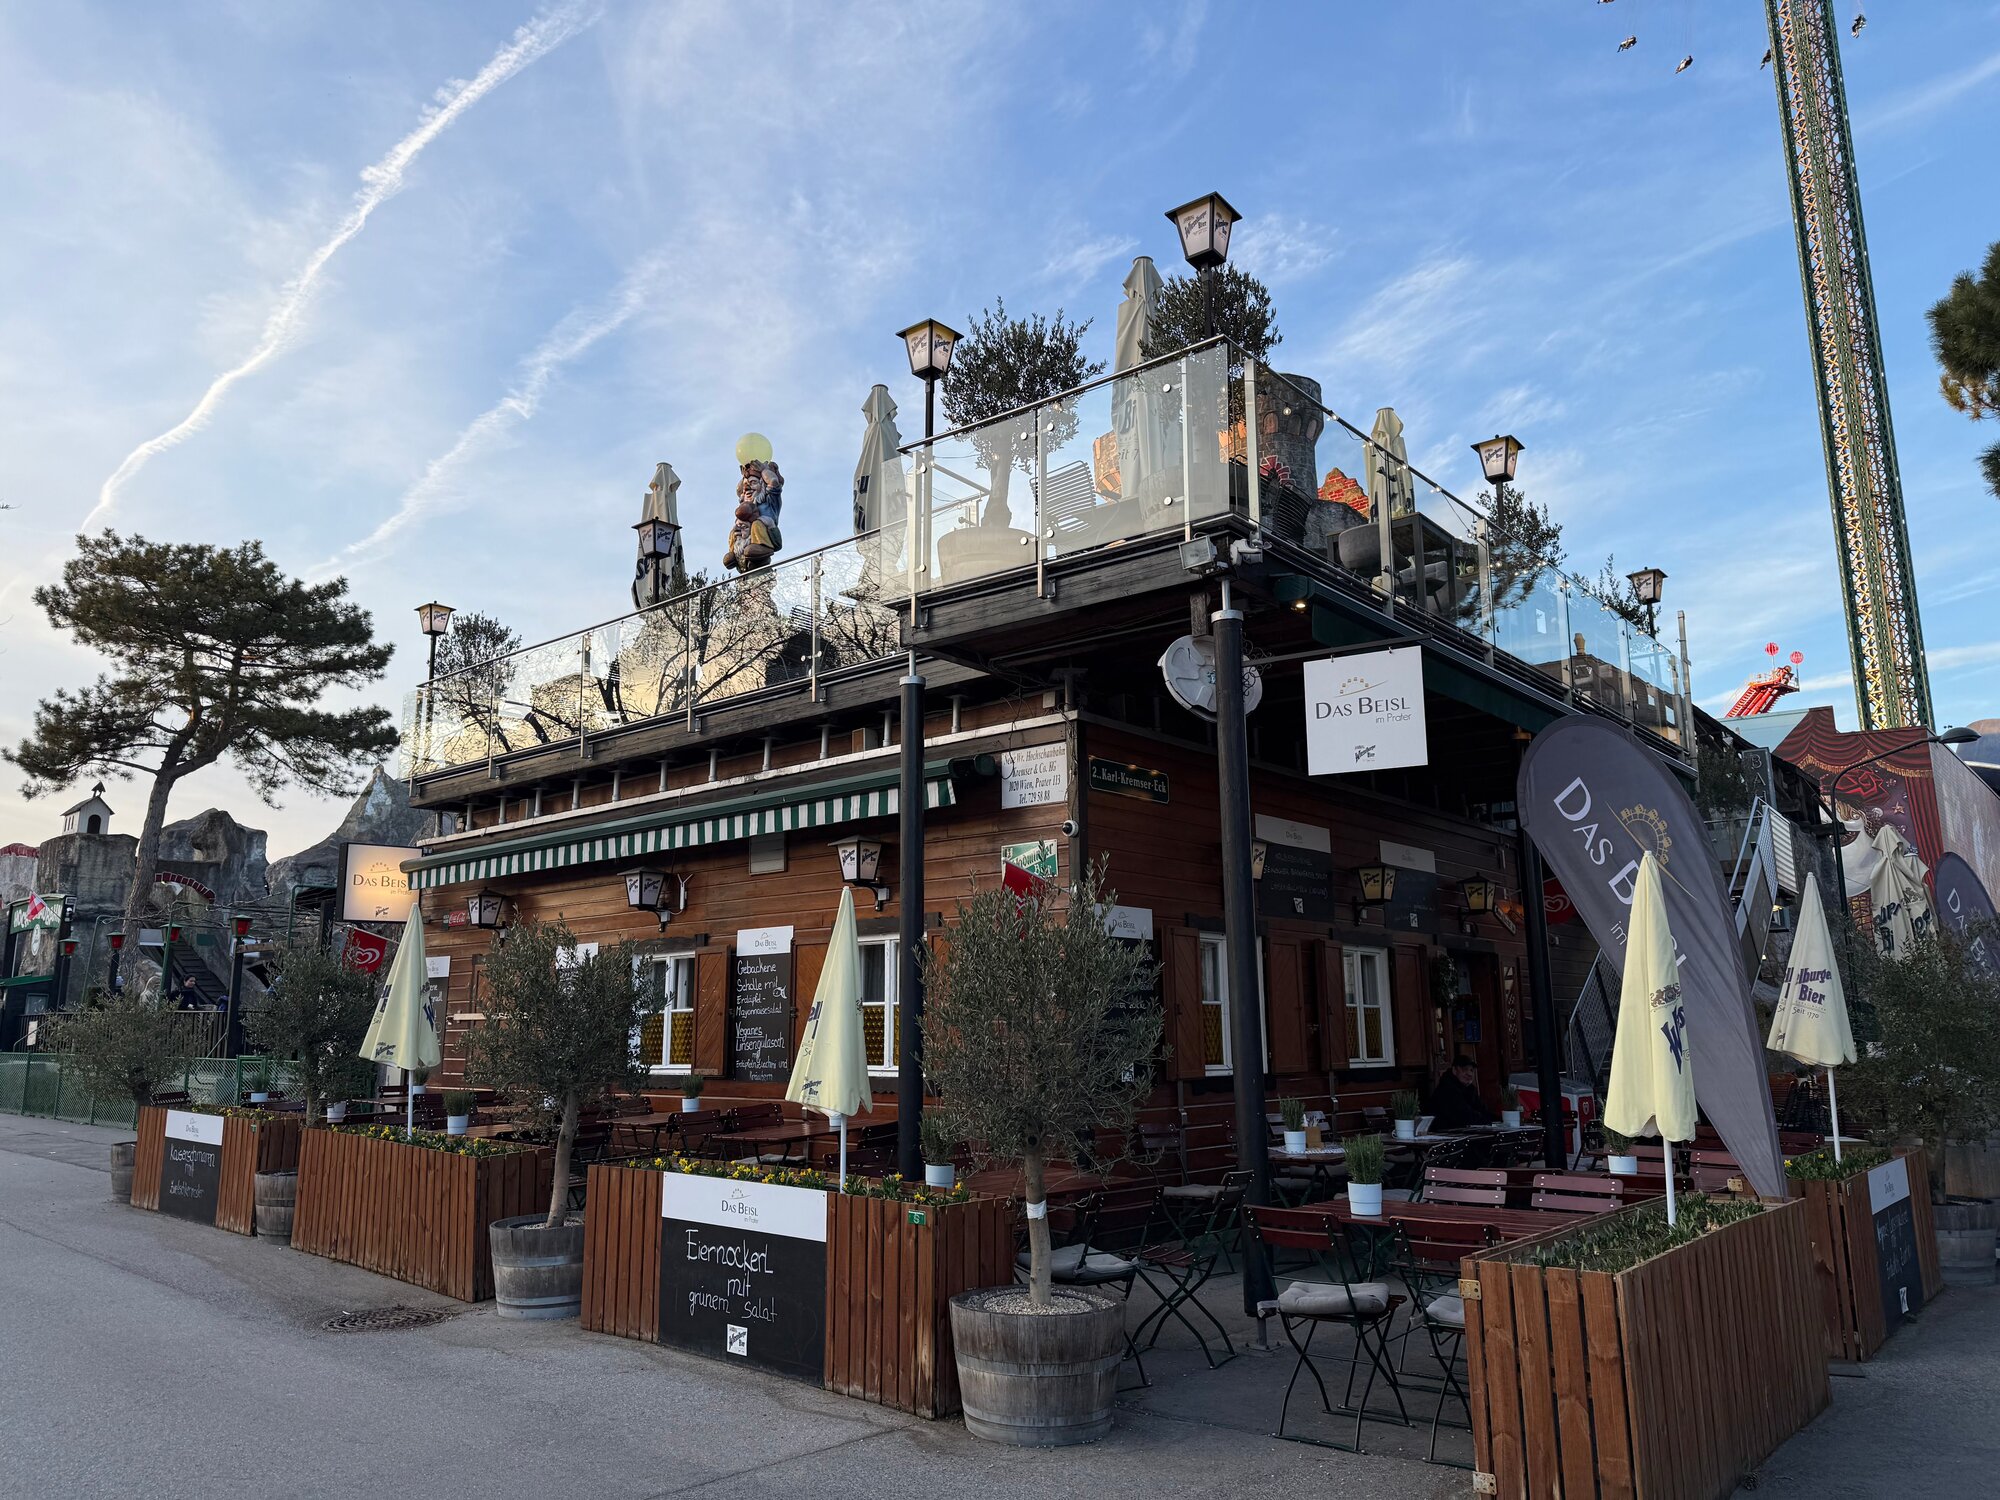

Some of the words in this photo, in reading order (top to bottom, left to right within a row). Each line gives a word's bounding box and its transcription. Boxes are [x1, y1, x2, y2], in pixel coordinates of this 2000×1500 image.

[1315, 702, 1353, 720] DAS
[1358, 697, 1411, 715] BEISL
[1375, 716, 1385, 724] im
[1387, 712, 1412, 723] Prater
[1035, 776, 1051, 789] Prater
[1553, 777, 1613, 865] DAS
[353, 874, 377, 887] DAS
[381, 875, 407, 889] BEIS
[736, 978, 762, 992] Scholle
[1798, 984, 1826, 1005] Bier
[1792, 1006, 1805, 1015] Seit
[721, 1200, 737, 1214] DAS
[738, 1202, 759, 1217] BEISL
[727, 1272, 751, 1297] mit
